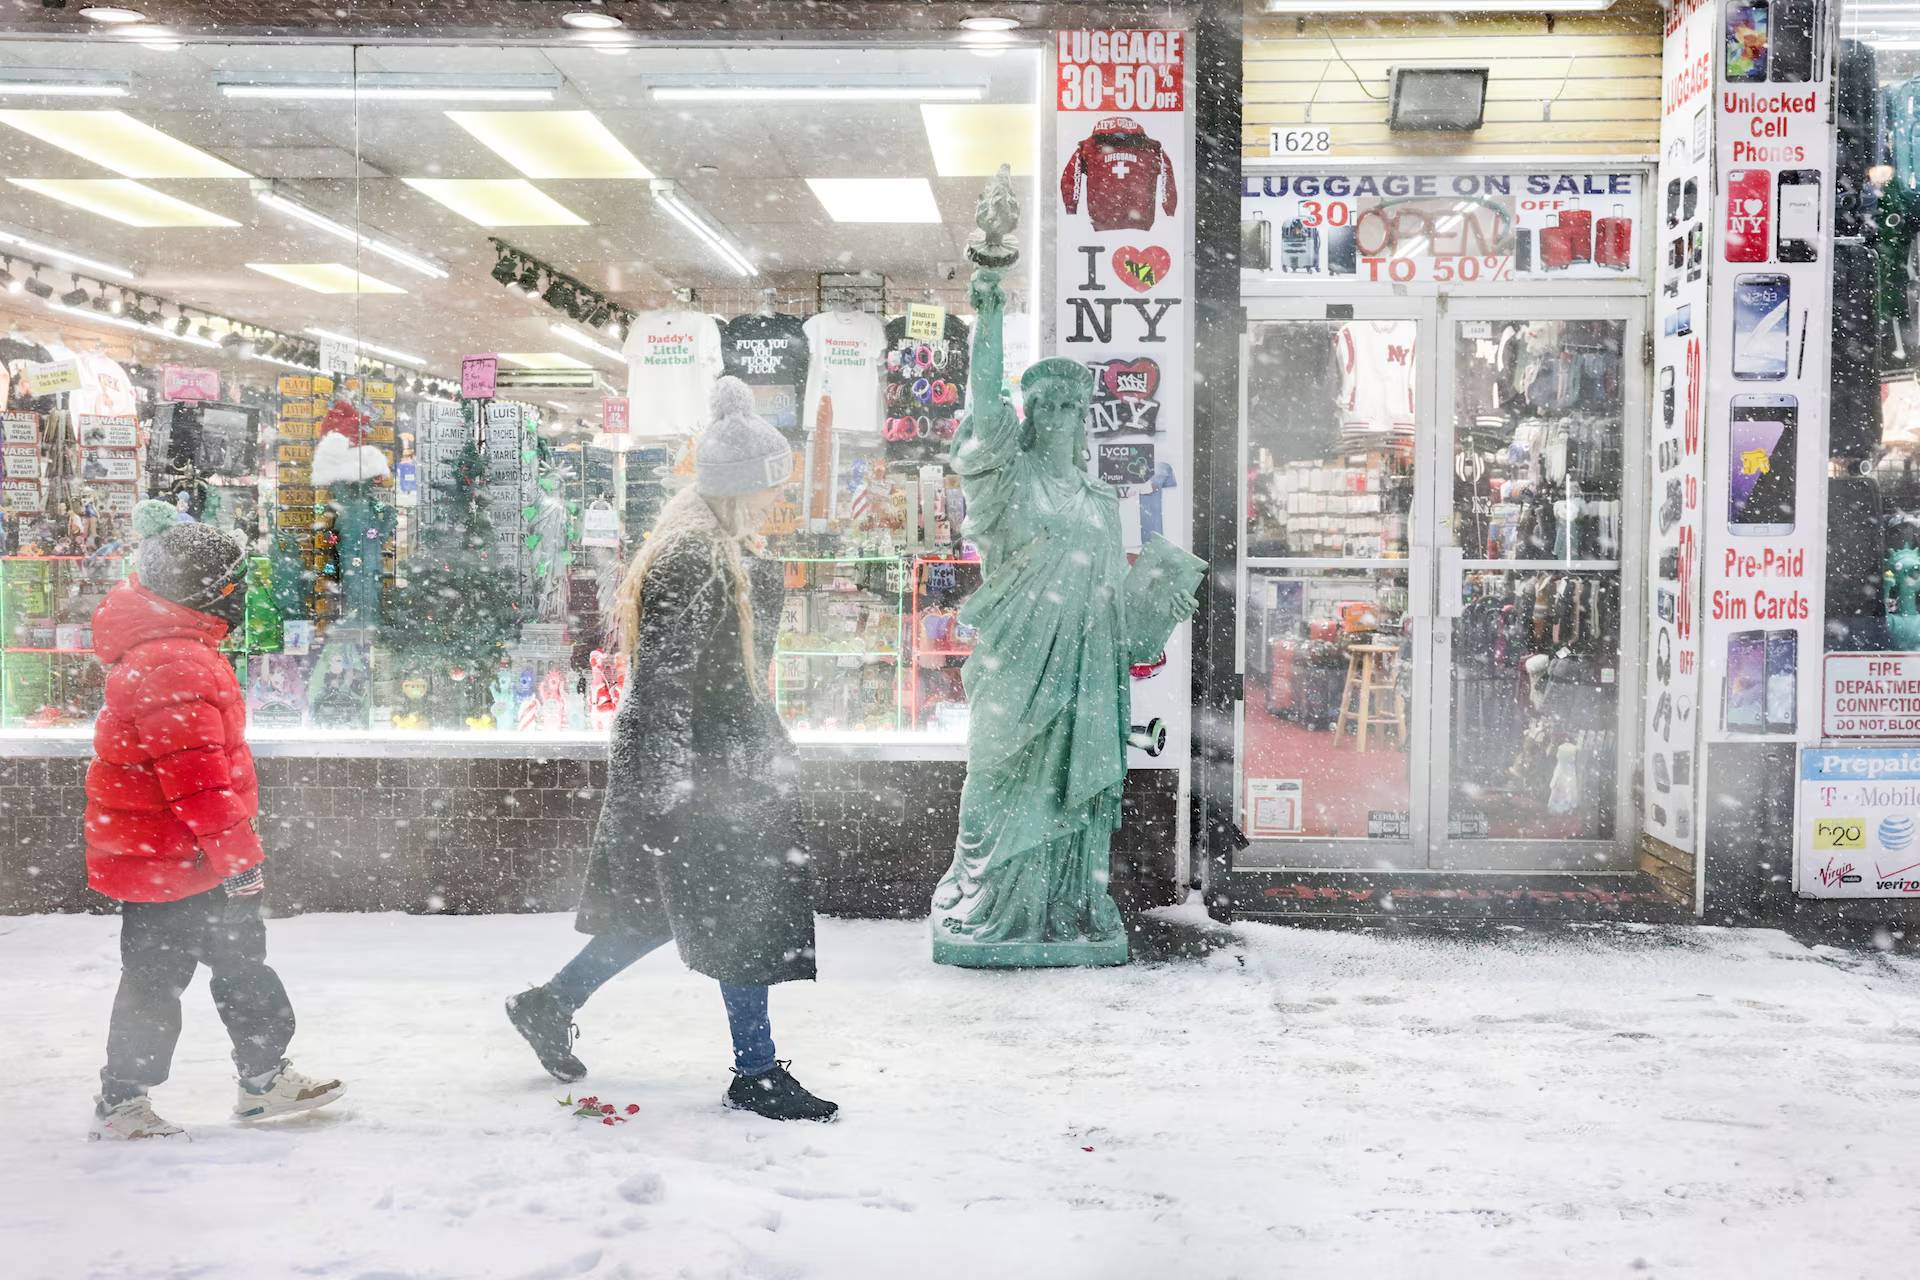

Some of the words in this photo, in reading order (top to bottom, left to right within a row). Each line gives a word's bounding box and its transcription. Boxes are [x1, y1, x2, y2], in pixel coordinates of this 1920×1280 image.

[1059, 31, 1180, 64] LUGGAGE
[1667, 53, 1709, 115] LUGGAGE
[1156, 92, 1178, 109] OFF
[1724, 91, 1816, 113] Unlocked
[1751, 117, 1788, 138] Cell
[1271, 131, 1330, 152] 1628
[1733, 141, 1805, 162] Phones
[1104, 152, 1138, 163] LIFEGUARD
[1241, 175, 1437, 198] LUGGAGE
[1452, 174, 1511, 195] ON
[1526, 174, 1632, 196] SALE
[1302, 200, 1348, 227] 30
[1521, 200, 1566, 210] OFF
[1733, 199, 1743, 215] I
[1356, 207, 1502, 257] OPEN
[1729, 216, 1766, 234] NY
[1078, 246, 1106, 291] I
[1361, 257, 1416, 283] TO
[1432, 256, 1514, 282] 50%
[1066, 298, 1182, 343] NY
[647, 334, 694, 345] Daddy's
[652, 344, 689, 355] Little
[736, 339, 767, 350] FUCK
[768, 339, 789, 350] YOU
[644, 354, 696, 366] Meatball
[752, 348, 772, 358] YOU
[831, 348, 860, 358] Little
[1387, 344, 1410, 366] NY
[747, 364, 776, 374] FUCK
[1088, 364, 1111, 397] I
[493, 408, 517, 419] LUIS
[1088, 396, 1159, 433] NY
[440, 428, 465, 439] JAMIE
[493, 450, 517, 460] MARIE
[1100, 446, 1129, 458] Lyca
[1725, 548, 1804, 578] Pre-Paid
[1713, 590, 1747, 620] Sim
[1750, 589, 1809, 621] Cards
[1680, 650, 1695, 675] OFF
[1869, 662, 1902, 676] FIRE
[1837, 719, 1855, 730] DO
[1859, 719, 1884, 730] NOT
[1819, 857, 1855, 888] Virgin
